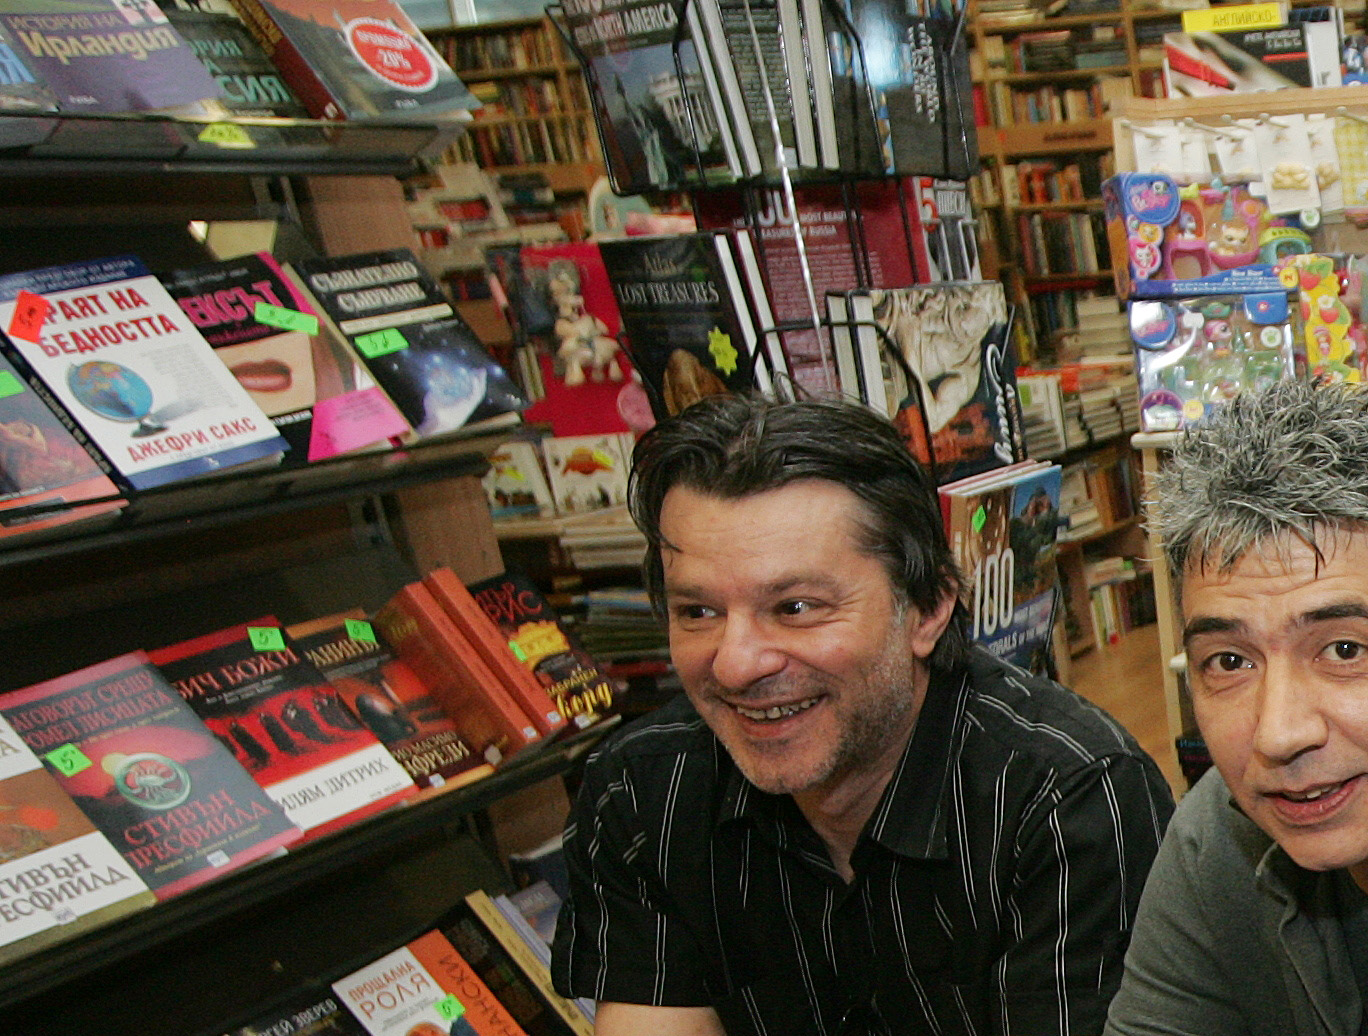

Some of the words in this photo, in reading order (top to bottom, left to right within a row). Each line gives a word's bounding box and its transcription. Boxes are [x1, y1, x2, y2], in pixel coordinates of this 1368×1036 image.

[18, 25, 180, 65] Ирландия
[43, 294, 109, 326] РАЯТ
[108, 287, 149, 311] НА
[39, 313, 181, 358] БЕДНОСТТА
[126, 428, 210, 463] ДЖЕФРИ
[209, 416, 258, 440] САКС
[973, 547, 1014, 641] 100
[12, 691, 98, 733] АГОВОРЪТ
[275, 786, 326, 813] ИЛЯМ
[325, 757, 391, 795] ДИТРИХ
[123, 789, 236, 846] СТИВЪН
[359, 973, 432, 1020] РОЛЯ
